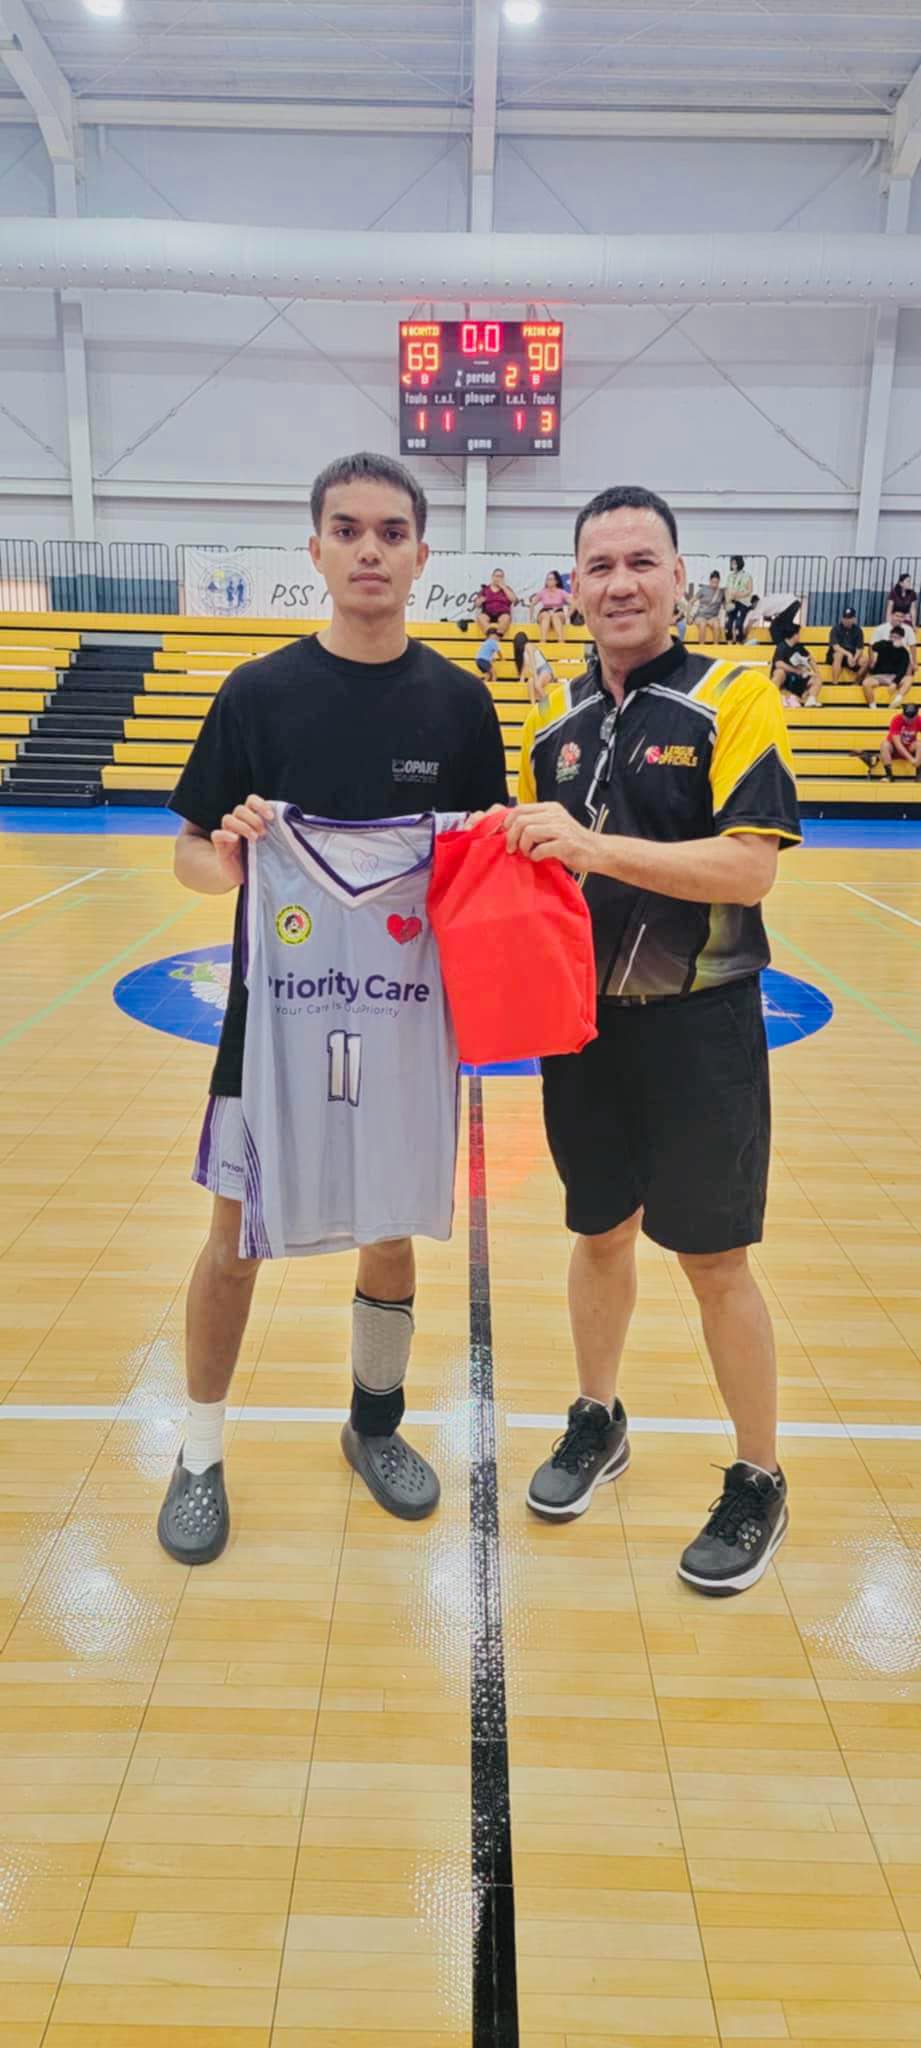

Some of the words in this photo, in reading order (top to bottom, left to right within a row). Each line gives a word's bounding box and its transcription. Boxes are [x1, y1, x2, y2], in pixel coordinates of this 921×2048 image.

[407, 342, 439, 371] 69
[528, 342, 559, 371] 90
[465, 371, 496, 385] period
[505, 365, 517, 388] 2
[464, 392, 496, 405] player
[541, 411, 553, 431] 3
[467, 439, 492, 450] game
[271, 584, 314, 606] PSS
[658, 753, 698, 767] OFFICIALS
[664, 745, 695, 756] LEAGUE
[268, 968, 360, 1003] riority
[365, 974, 430, 1002] Care
[328, 1030, 362, 1107] 11
